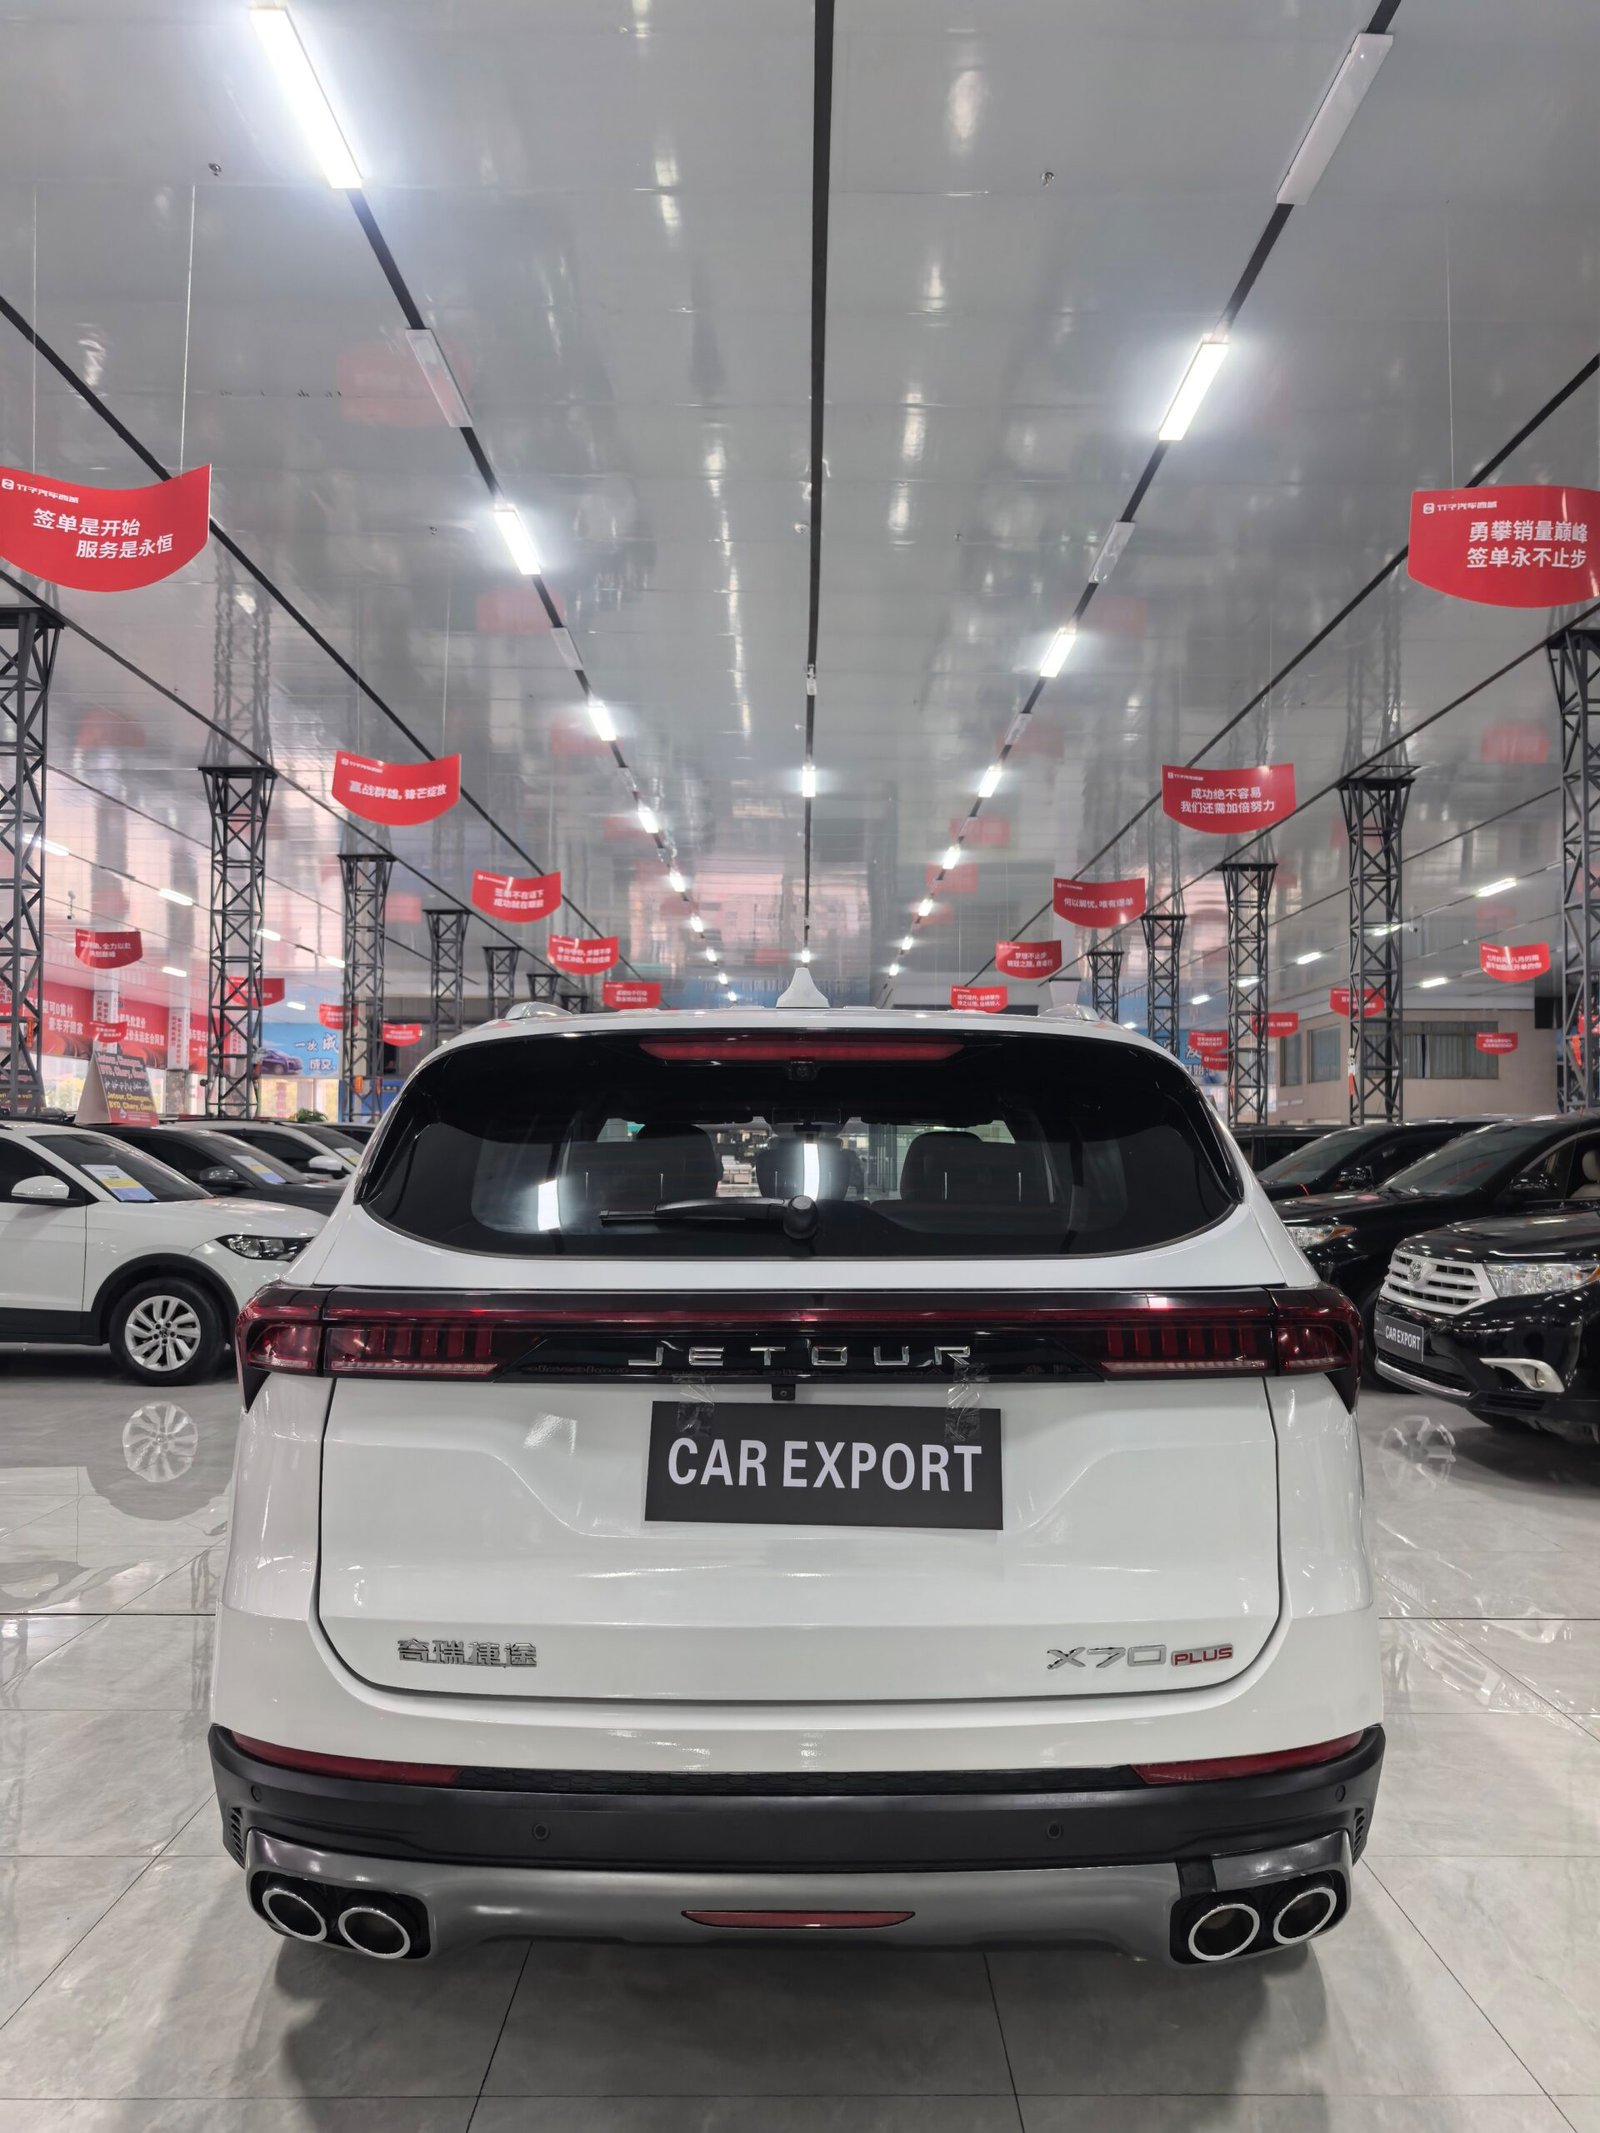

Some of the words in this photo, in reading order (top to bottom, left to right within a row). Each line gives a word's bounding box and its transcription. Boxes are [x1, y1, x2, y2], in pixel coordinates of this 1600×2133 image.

[32, 507, 141, 538] 签单是开始
[1468, 519, 1589, 544] 勇攀销量巅峰
[76, 533, 174, 560] 服务是永恒
[1466, 547, 1587, 569] 签单永不止步
[1190, 786, 1262, 800] 成功绝不容易
[1180, 799, 1276, 815] 我们还需加倍努力
[1385, 1325, 1397, 1342] CAR
[1396, 1329, 1421, 1351] EXPORT
[627, 1345, 971, 1367] JETOUR
[667, 1437, 768, 1489] CAR
[781, 1440, 983, 1492] EXPORT
[397, 1638, 538, 1668] 奇瑞捷途
[1046, 1644, 1168, 1670] X70
[1174, 1647, 1233, 1665] PLUS
